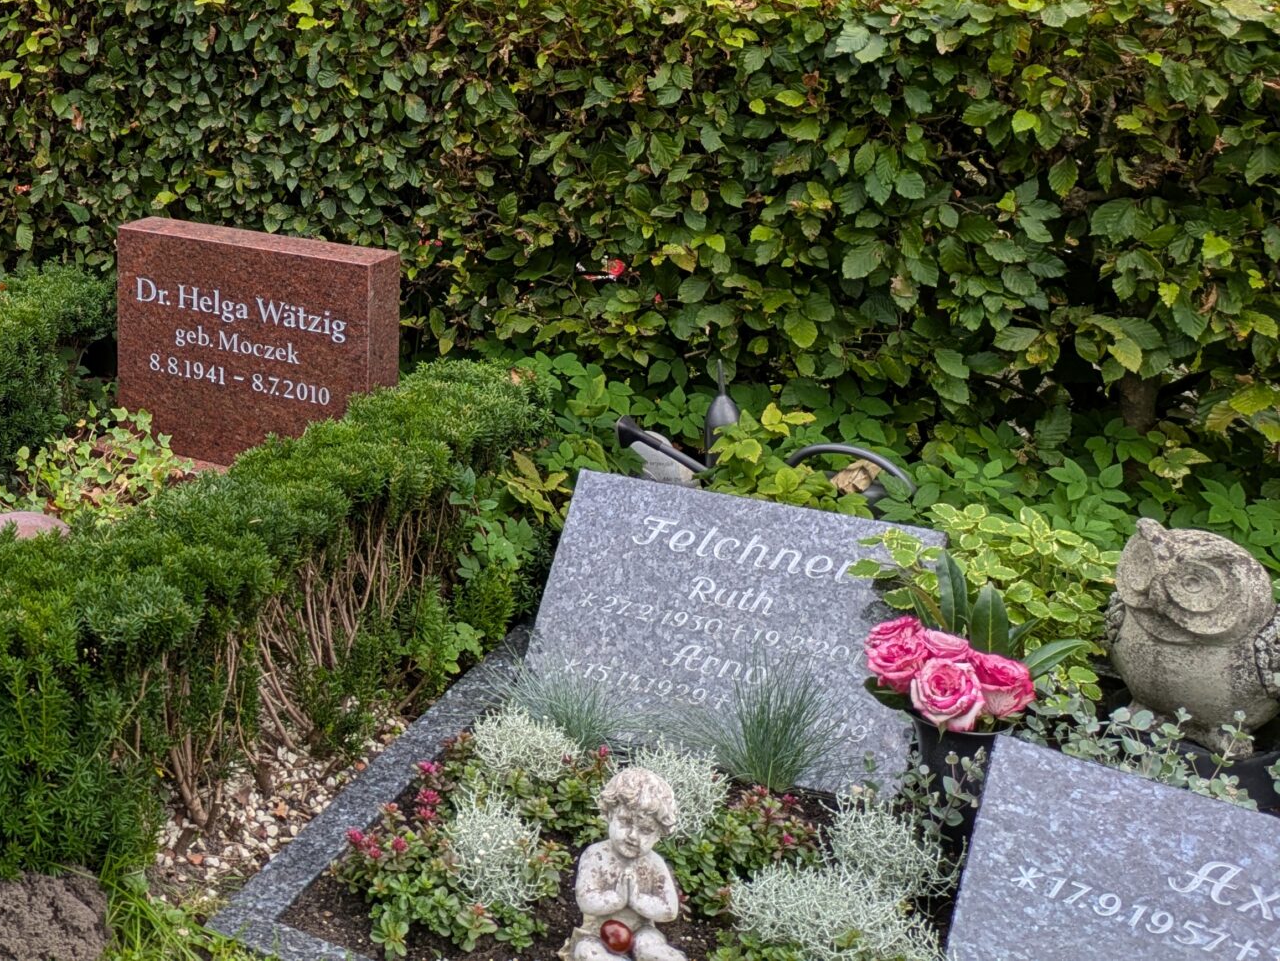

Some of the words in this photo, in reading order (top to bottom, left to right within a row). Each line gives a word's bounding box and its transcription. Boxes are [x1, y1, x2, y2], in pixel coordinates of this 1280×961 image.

[135, 276, 171, 306] Dr.
[177, 284, 249, 323] Helga
[256, 296, 348, 344] Wätzig
[175, 325, 214, 348] geb.
[218, 330, 301, 365] Moczek
[632, 515, 854, 584] Felchner
[688, 575, 775, 617] Ruth
[662, 644, 767, 685] Arno
